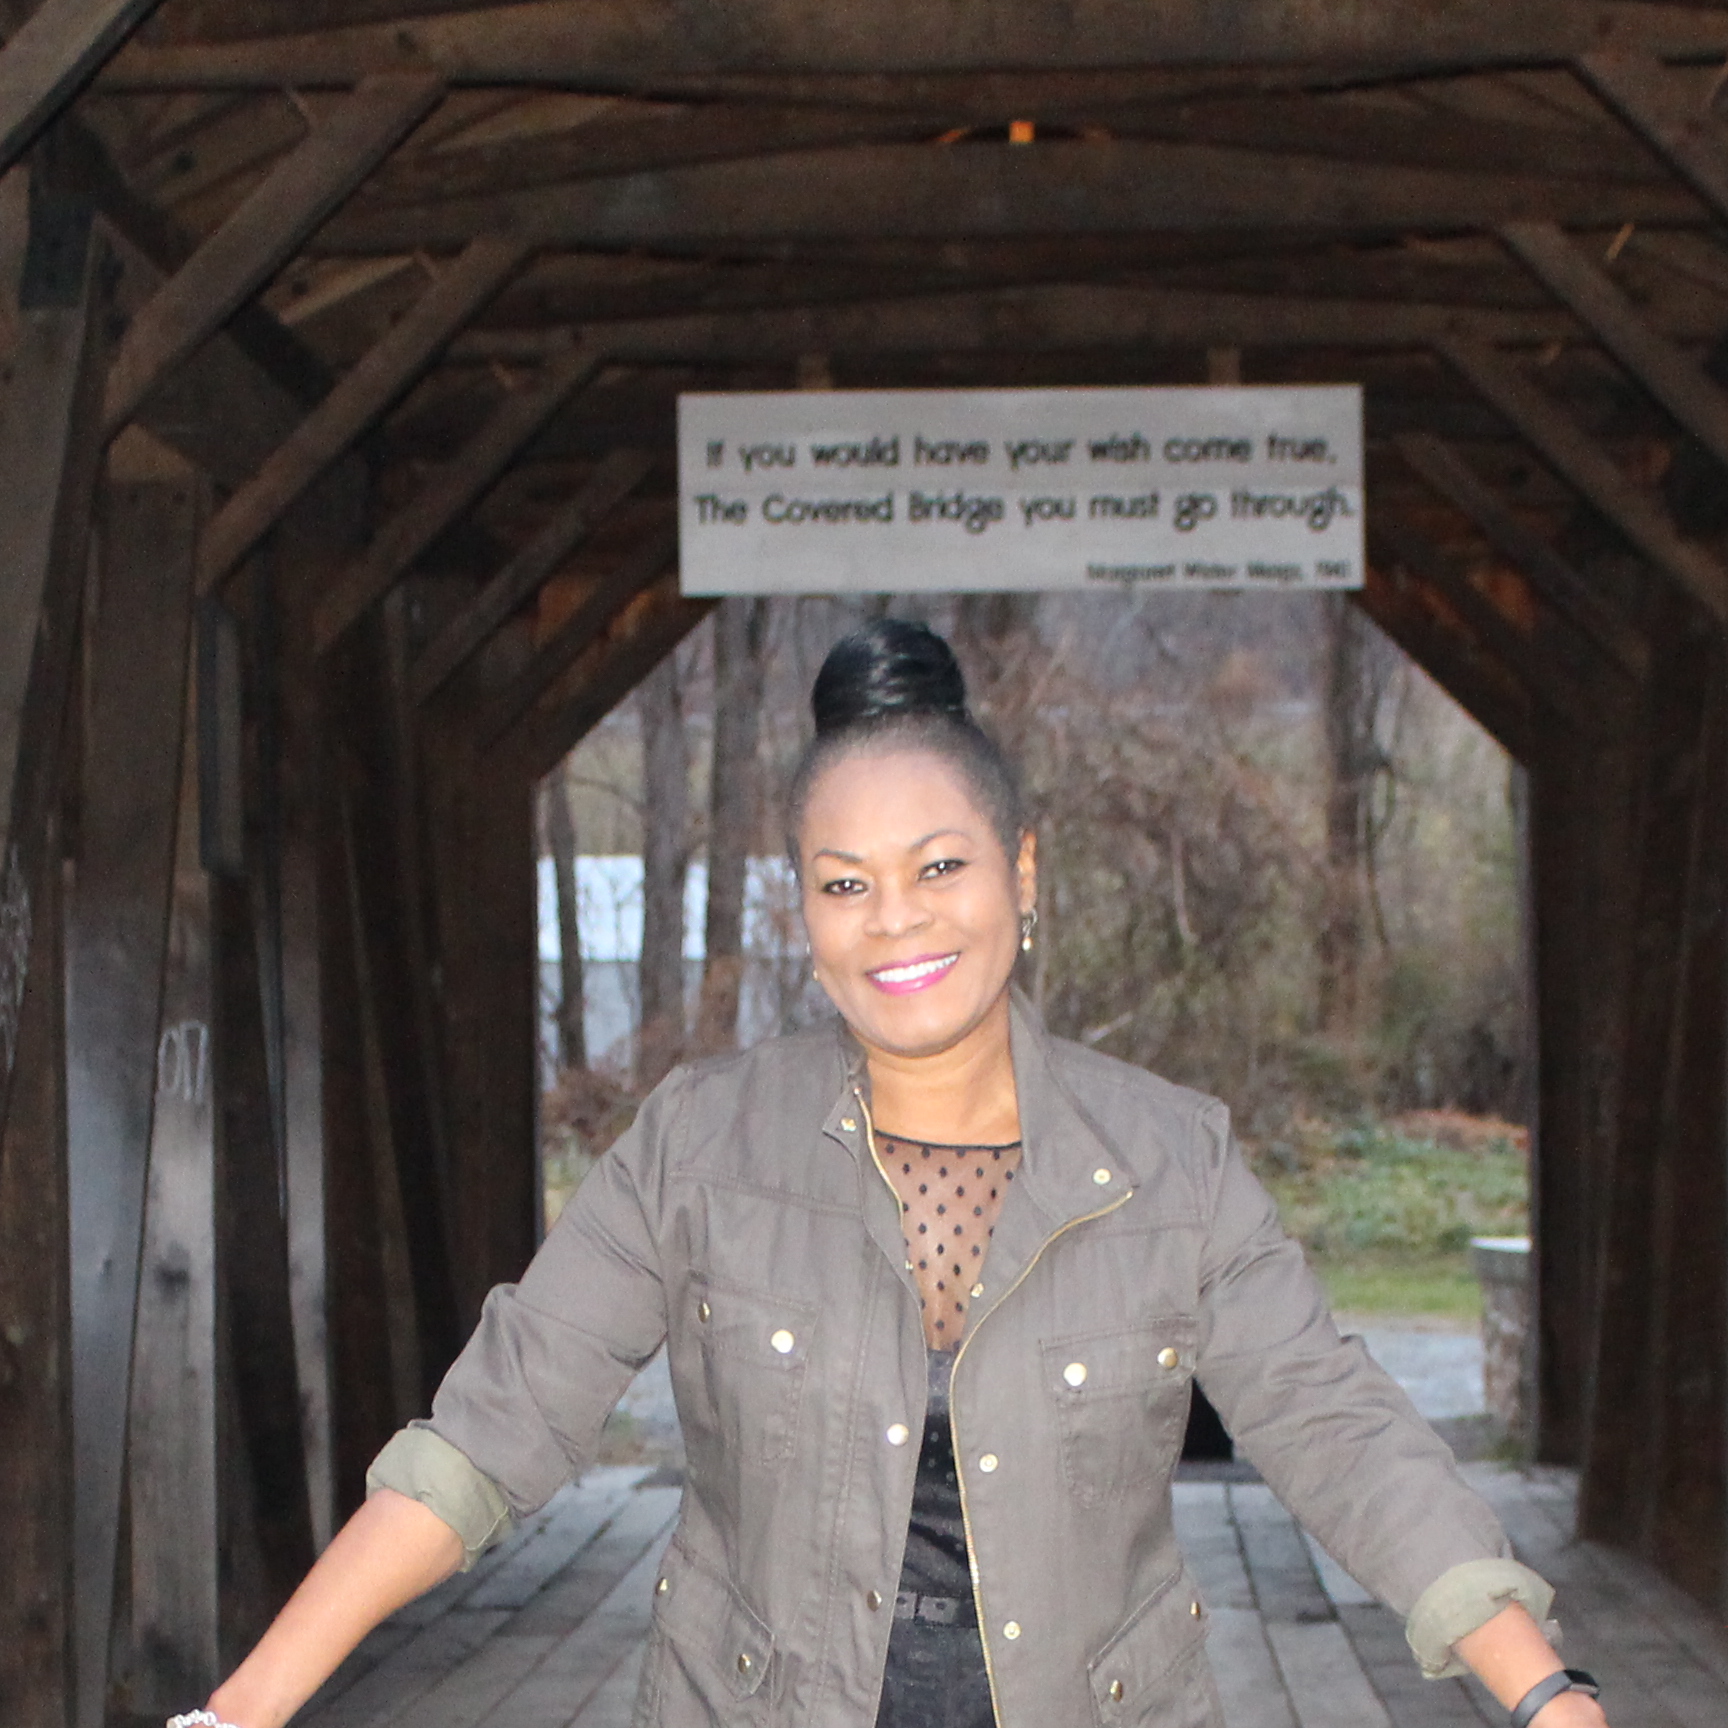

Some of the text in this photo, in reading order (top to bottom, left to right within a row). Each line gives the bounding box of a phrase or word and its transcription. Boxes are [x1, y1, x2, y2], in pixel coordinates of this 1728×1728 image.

[706, 439, 724, 468] If
[739, 443, 796, 473] you
[811, 436, 900, 467] would
[914, 434, 991, 466] have
[1004, 439, 1075, 471] your
[1088, 433, 1151, 463] wish
[1165, 438, 1251, 463] come
[694, 494, 748, 524] The
[762, 493, 894, 523] Covered
[907, 490, 1004, 534] Bridge
[1020, 498, 1076, 527] you
[1089, 493, 1159, 519] must
[1174, 494, 1219, 532] go
